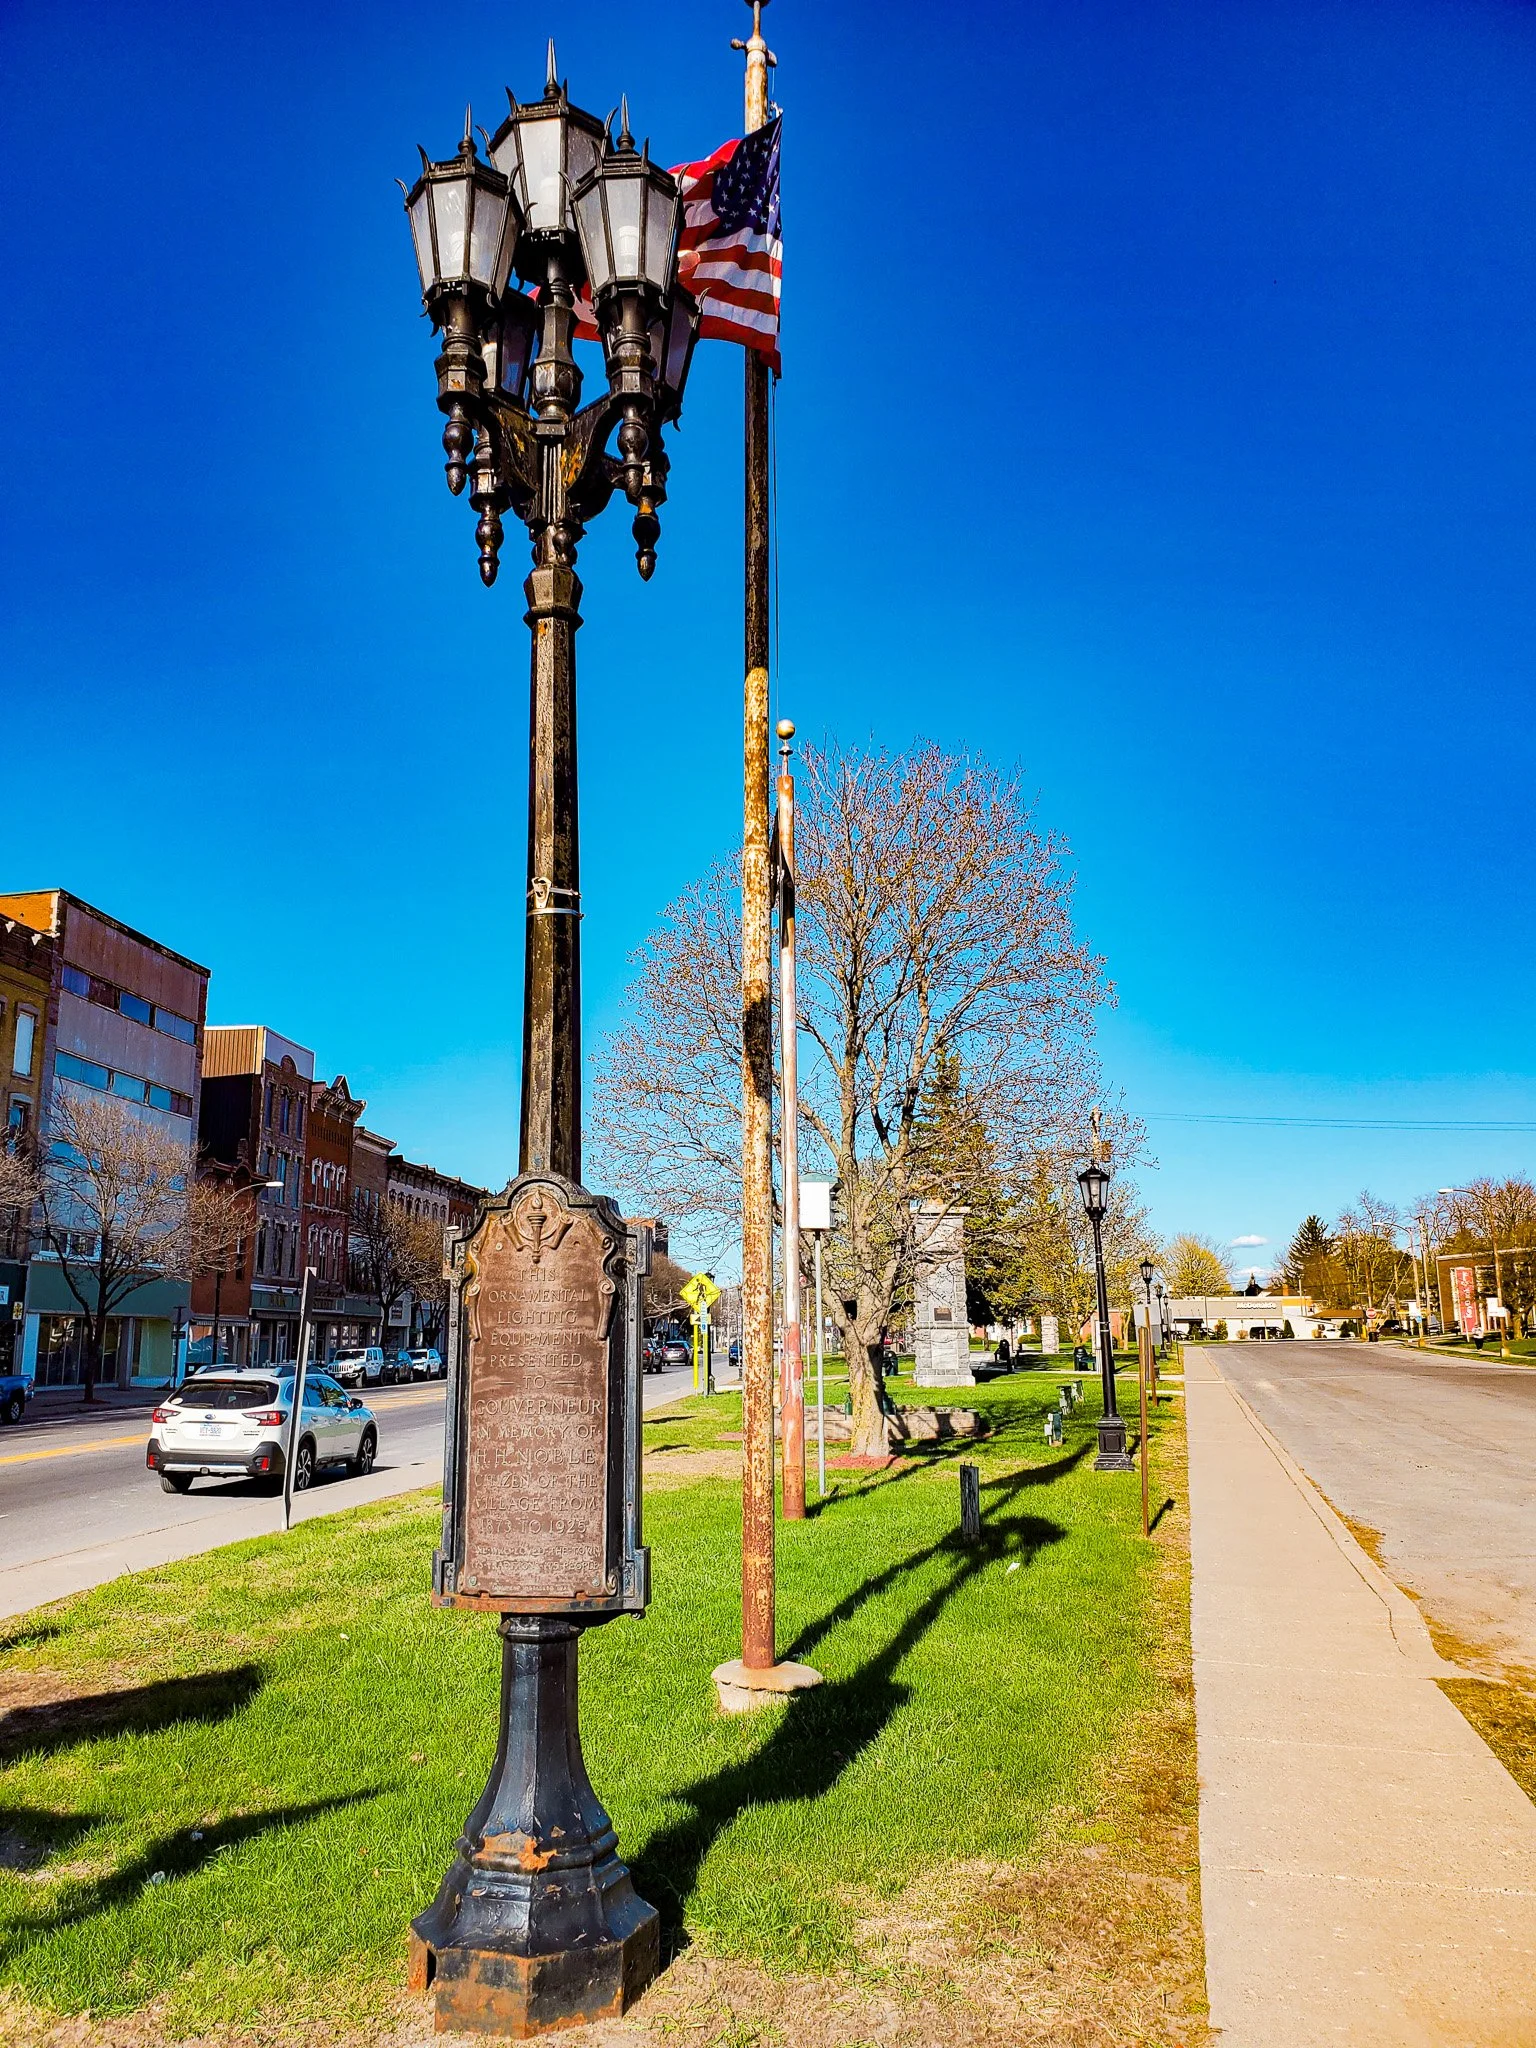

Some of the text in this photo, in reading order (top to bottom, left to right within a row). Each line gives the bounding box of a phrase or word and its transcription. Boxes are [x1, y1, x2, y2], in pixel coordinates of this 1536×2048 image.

[519, 1269, 556, 1281] THIS
[488, 1289, 588, 1302] ORNAMENTAL
[497, 1310, 577, 1324] LIGHTING
[490, 1332, 583, 1346] EQUIPMENT
[490, 1353, 583, 1368] PRESENTED
[523, 1375, 547, 1389] TO
[474, 1399, 603, 1415] GOUVERNEUR
[476, 1424, 598, 1438] IN MEMORY OF
[475, 1448, 596, 1465] H. H. NOBLE
[474, 1474, 598, 1488] CITIZEN OF THE
[475, 1497, 598, 1511] VILLAGE FROM
[479, 1519, 587, 1534] 1873 TO 1925
